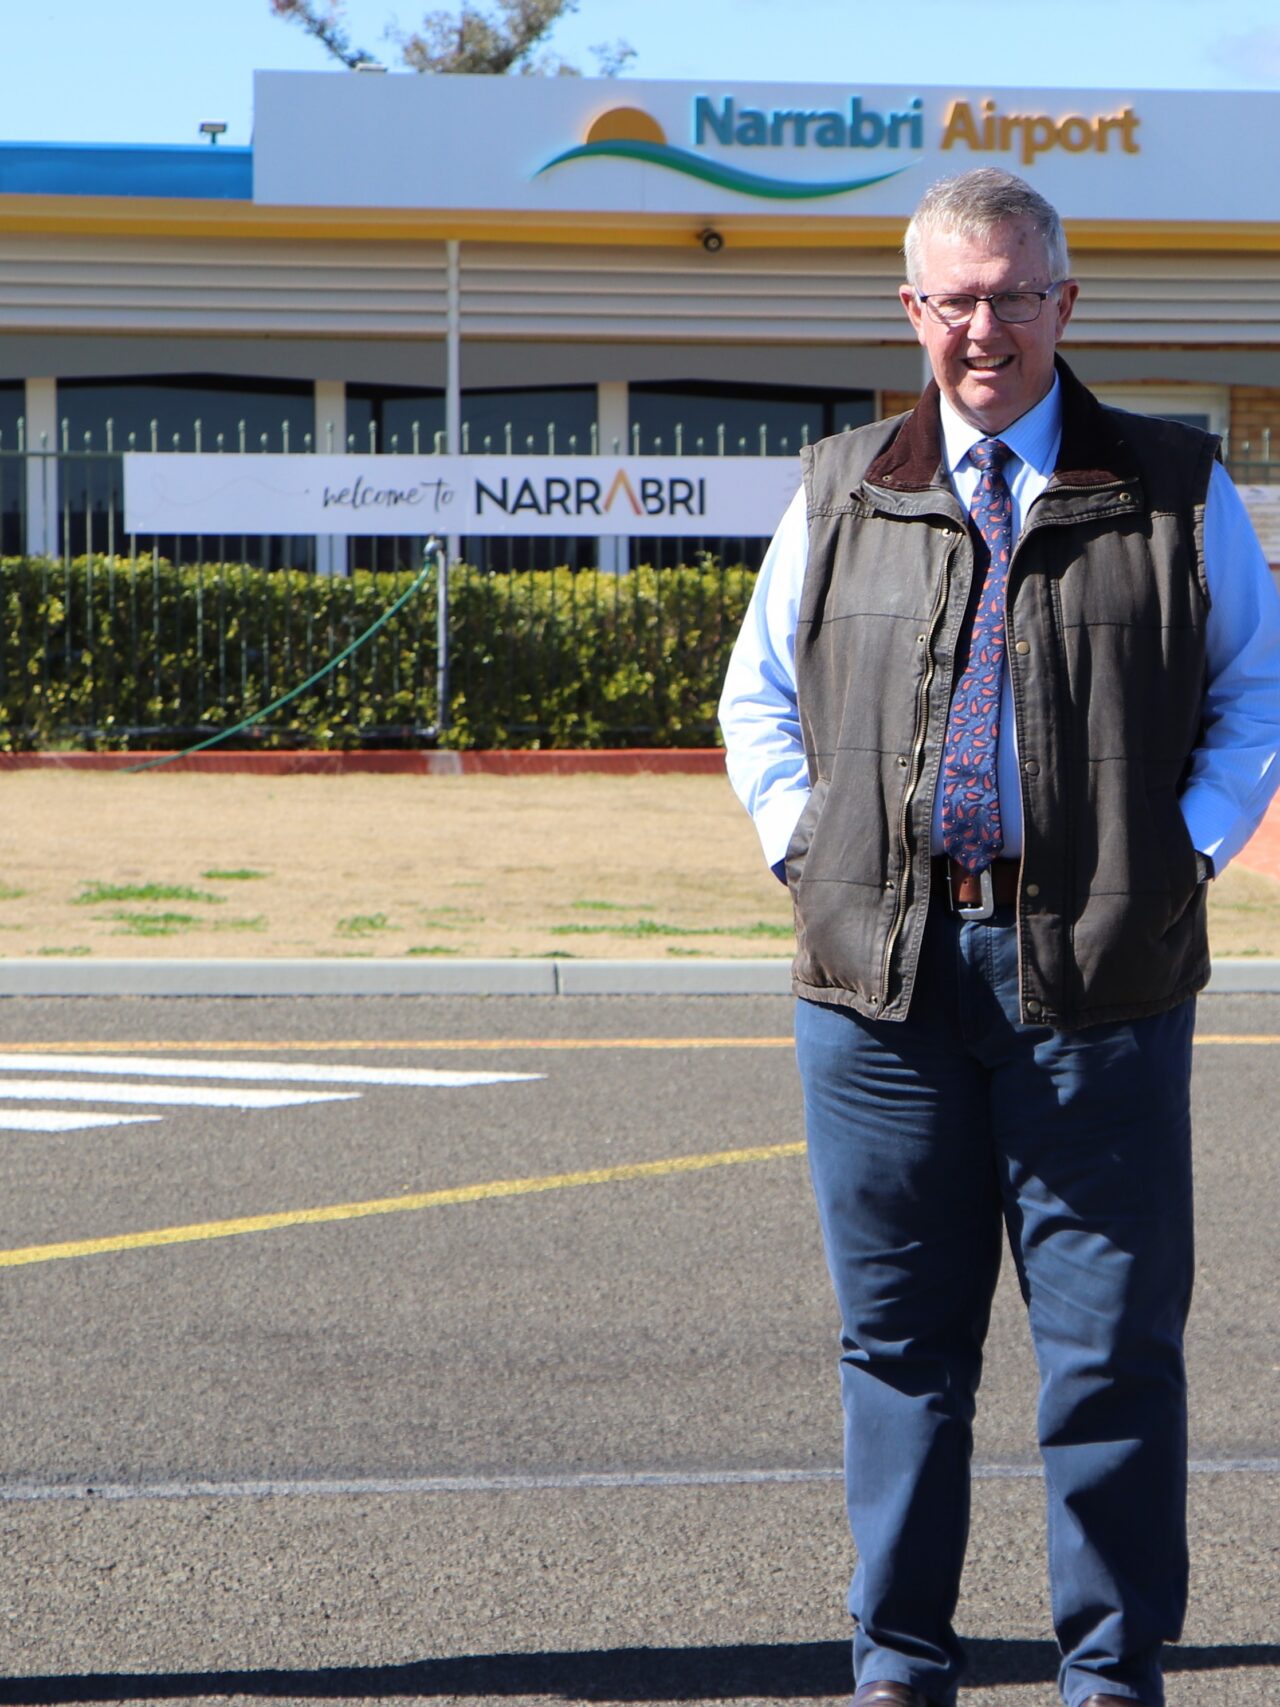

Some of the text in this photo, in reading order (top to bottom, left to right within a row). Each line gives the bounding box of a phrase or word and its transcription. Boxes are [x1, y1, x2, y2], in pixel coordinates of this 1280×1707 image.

[695, 95, 1140, 165] Narrabri Airport
[322, 468, 706, 515] welcome to NARRABRI
